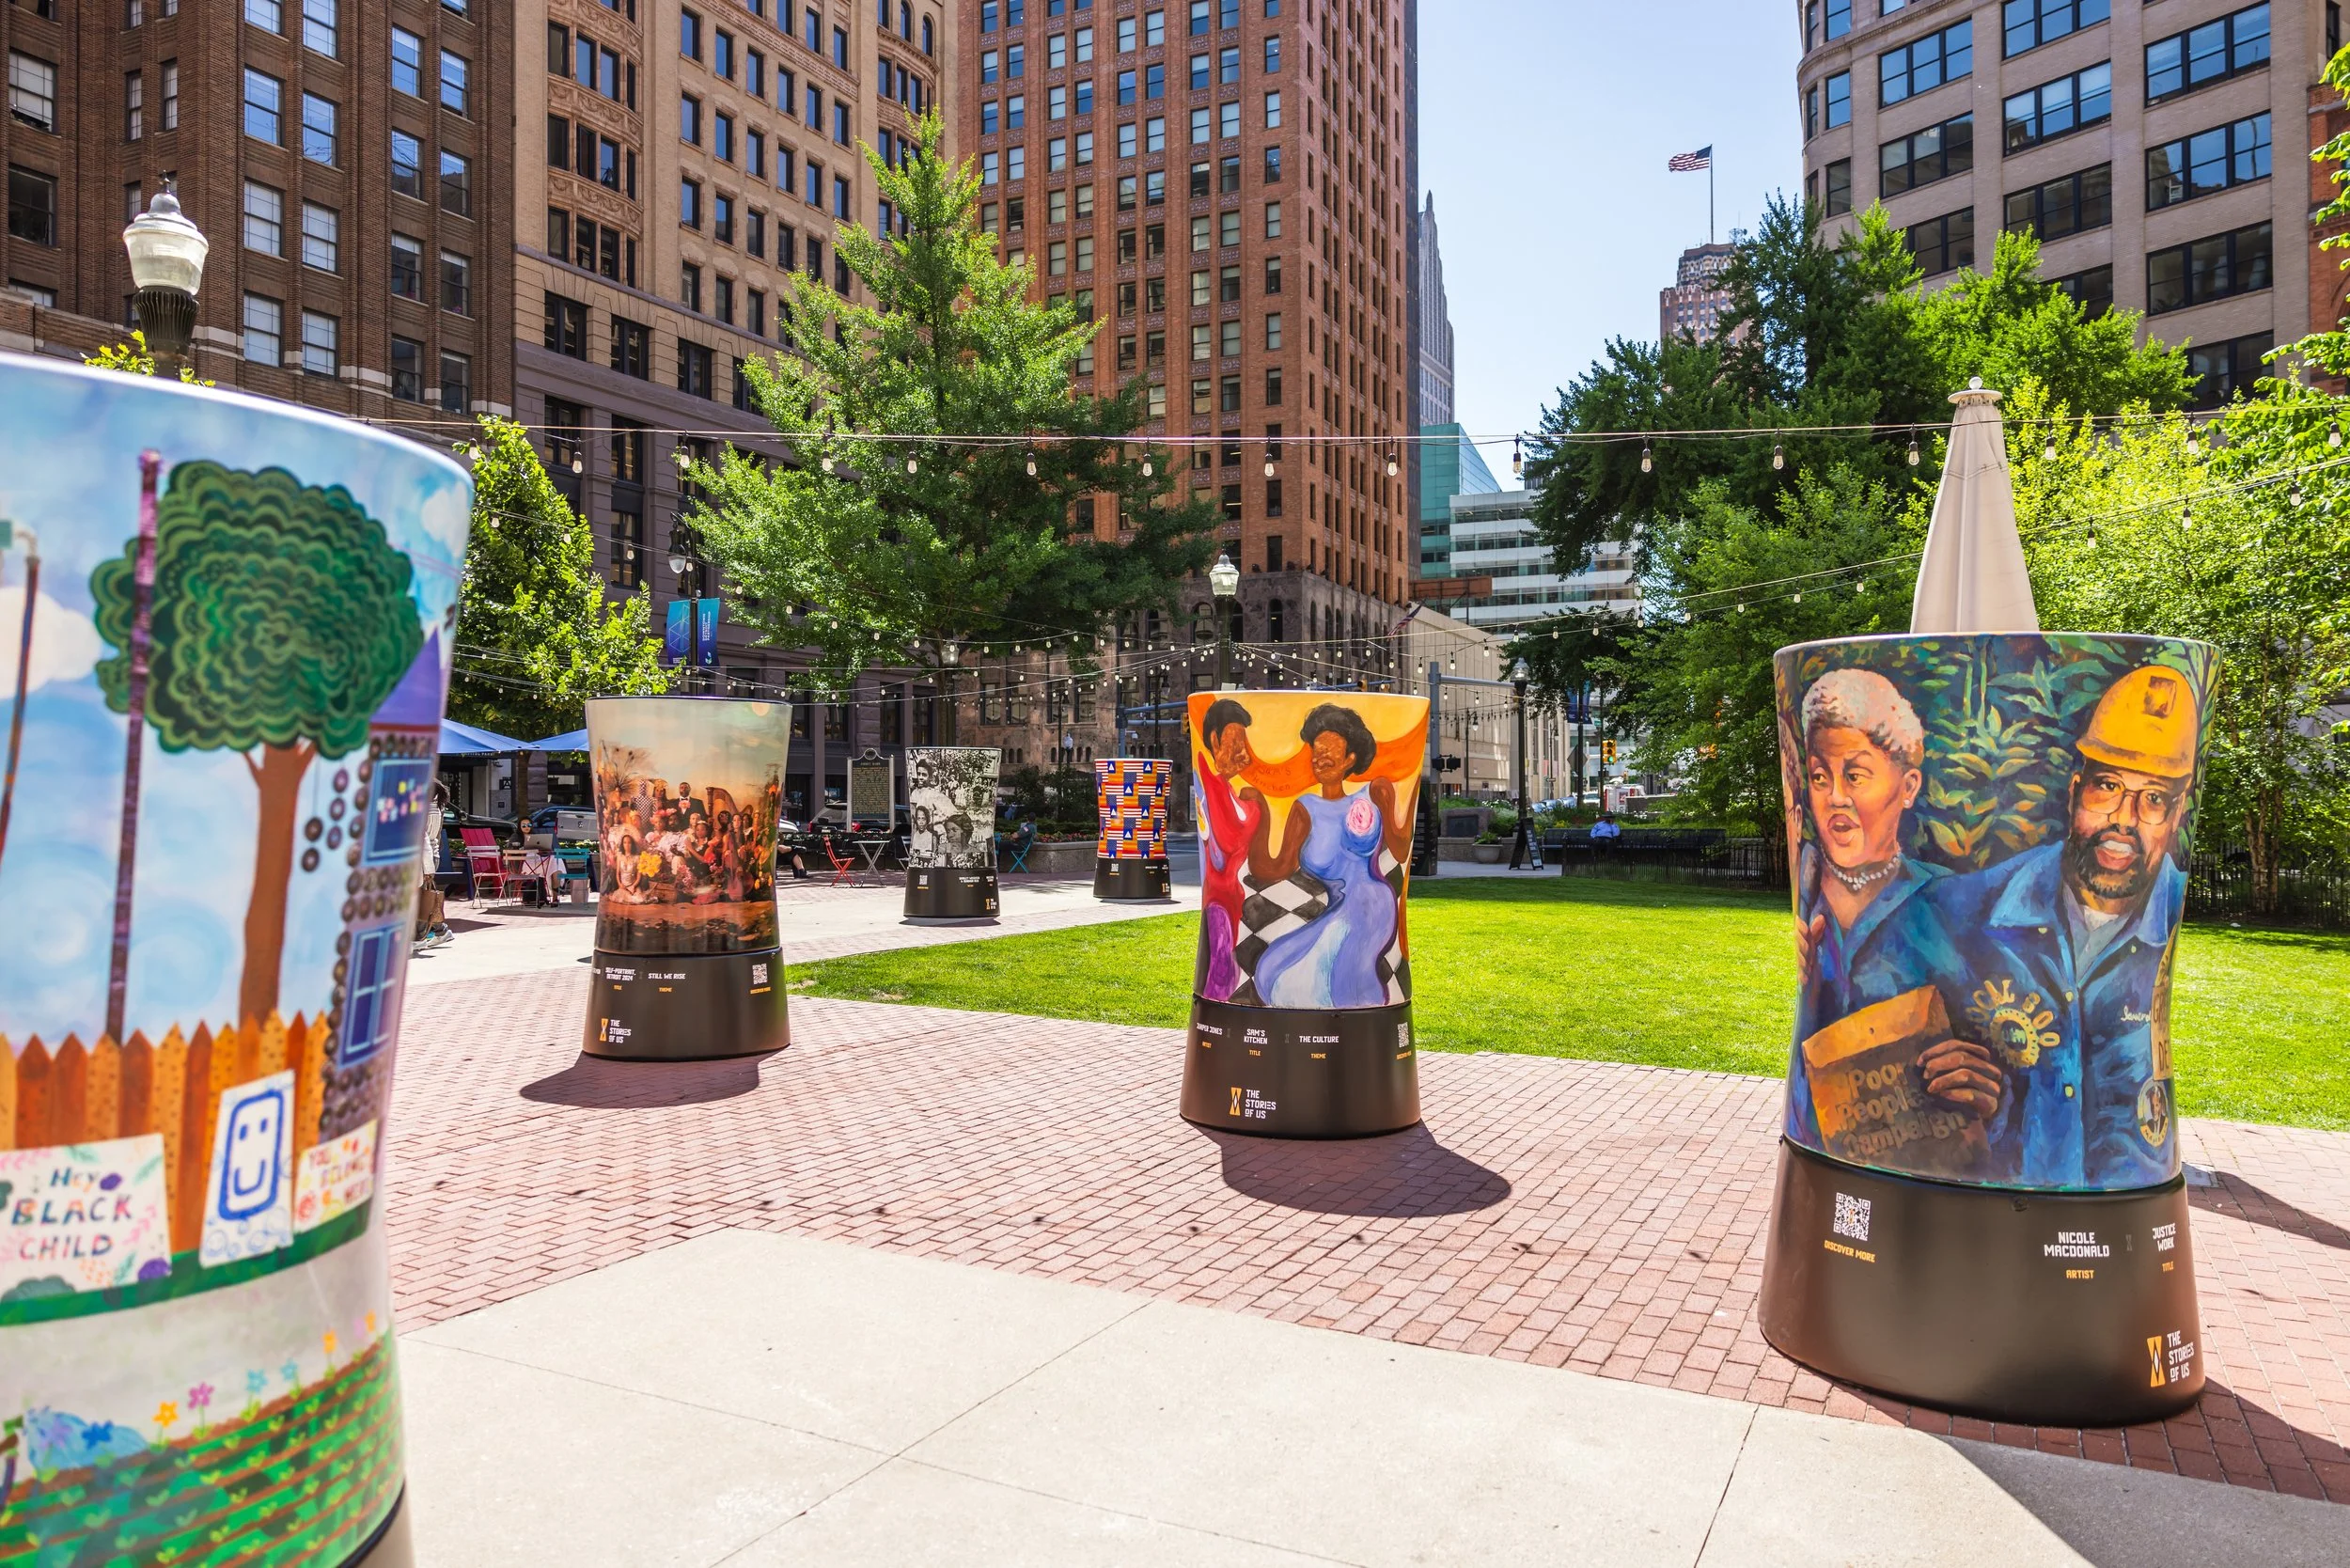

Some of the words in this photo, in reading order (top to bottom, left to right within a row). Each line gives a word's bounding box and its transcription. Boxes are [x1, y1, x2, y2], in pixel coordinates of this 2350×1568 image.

[609, 1027, 632, 1036] STORIES
[1246, 1028, 1265, 1037] SAM'S
[1244, 1036, 1268, 1044] KITCHEN
[1299, 1035, 1311, 1043] THE
[1312, 1035, 1340, 1043] CULTURE
[1246, 1089, 1261, 1099] THE
[1245, 1099, 1277, 1110] STORIES
[1245, 1109, 1254, 1118] OF
[1256, 1110, 1266, 1119] US
[11, 1194, 132, 1226] BLACK
[2058, 1231, 2096, 1245] NICOLE
[2152, 1223, 2176, 1240] JUSTICE
[19, 1233, 114, 1262] CHILD
[2044, 1244, 2110, 1258] MACDONALD
[2157, 1236, 2174, 1252] WORK
[1824, 1240, 1855, 1257] DISCOVER
[1856, 1249, 1876, 1263] MORE
[2162, 1261, 2174, 1272] TITLE
[2065, 1269, 2095, 1279] ARTIST
[2167, 1330, 2181, 1348] THE
[2169, 1341, 2195, 1365] STORIES
[2170, 1366, 2180, 1383] OF
[2181, 1362, 2190, 1379] US
